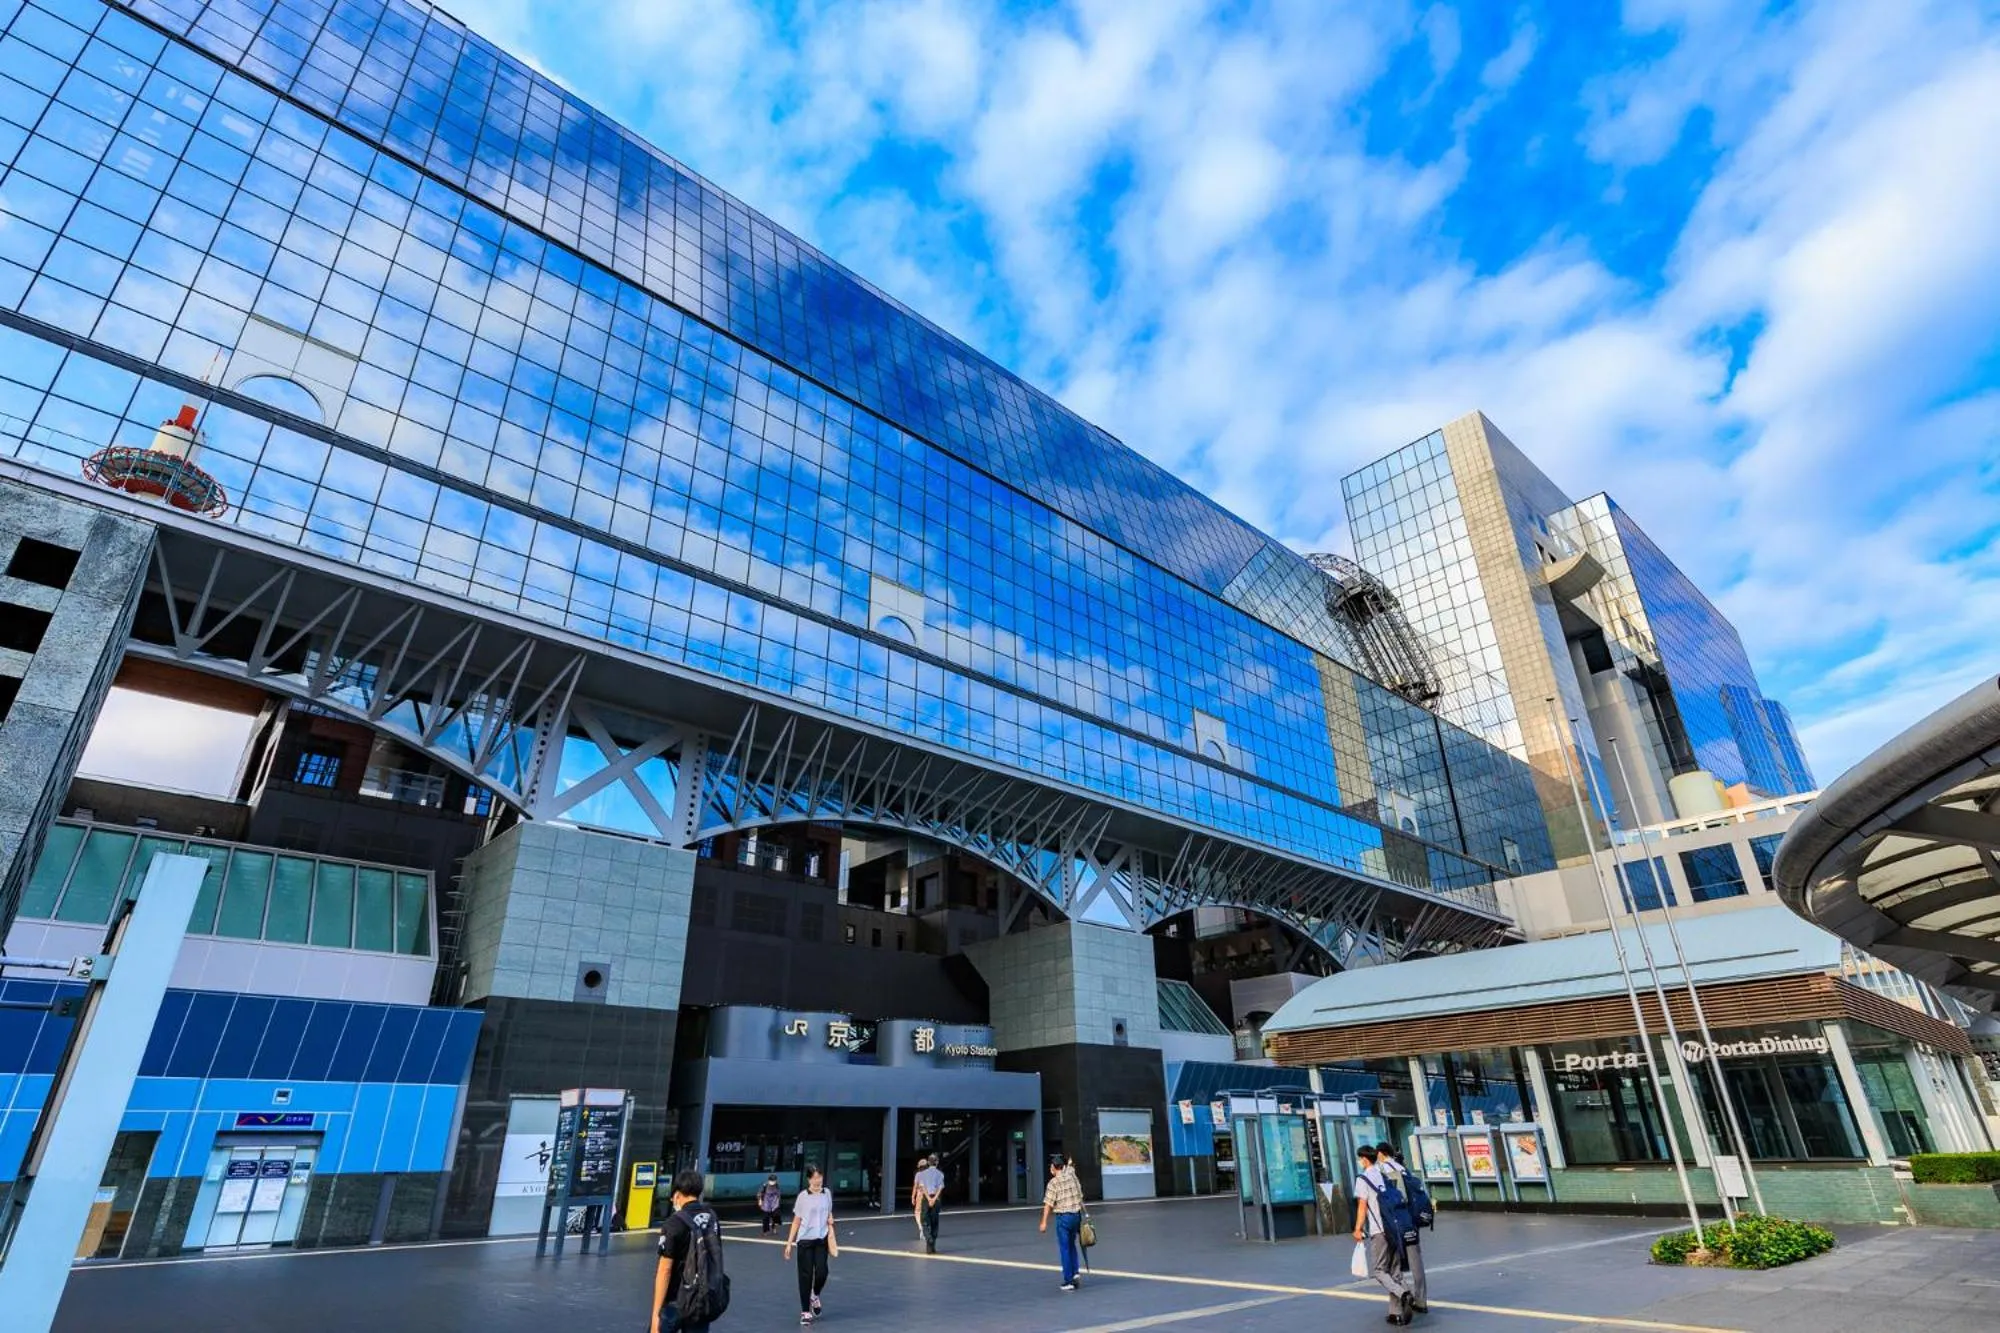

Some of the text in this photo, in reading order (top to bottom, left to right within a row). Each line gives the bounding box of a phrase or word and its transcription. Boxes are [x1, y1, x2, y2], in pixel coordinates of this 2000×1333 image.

[784, 1019, 998, 1057] JR 京 都 Kyoto Station
[1564, 1050, 1639, 1073] Porta
